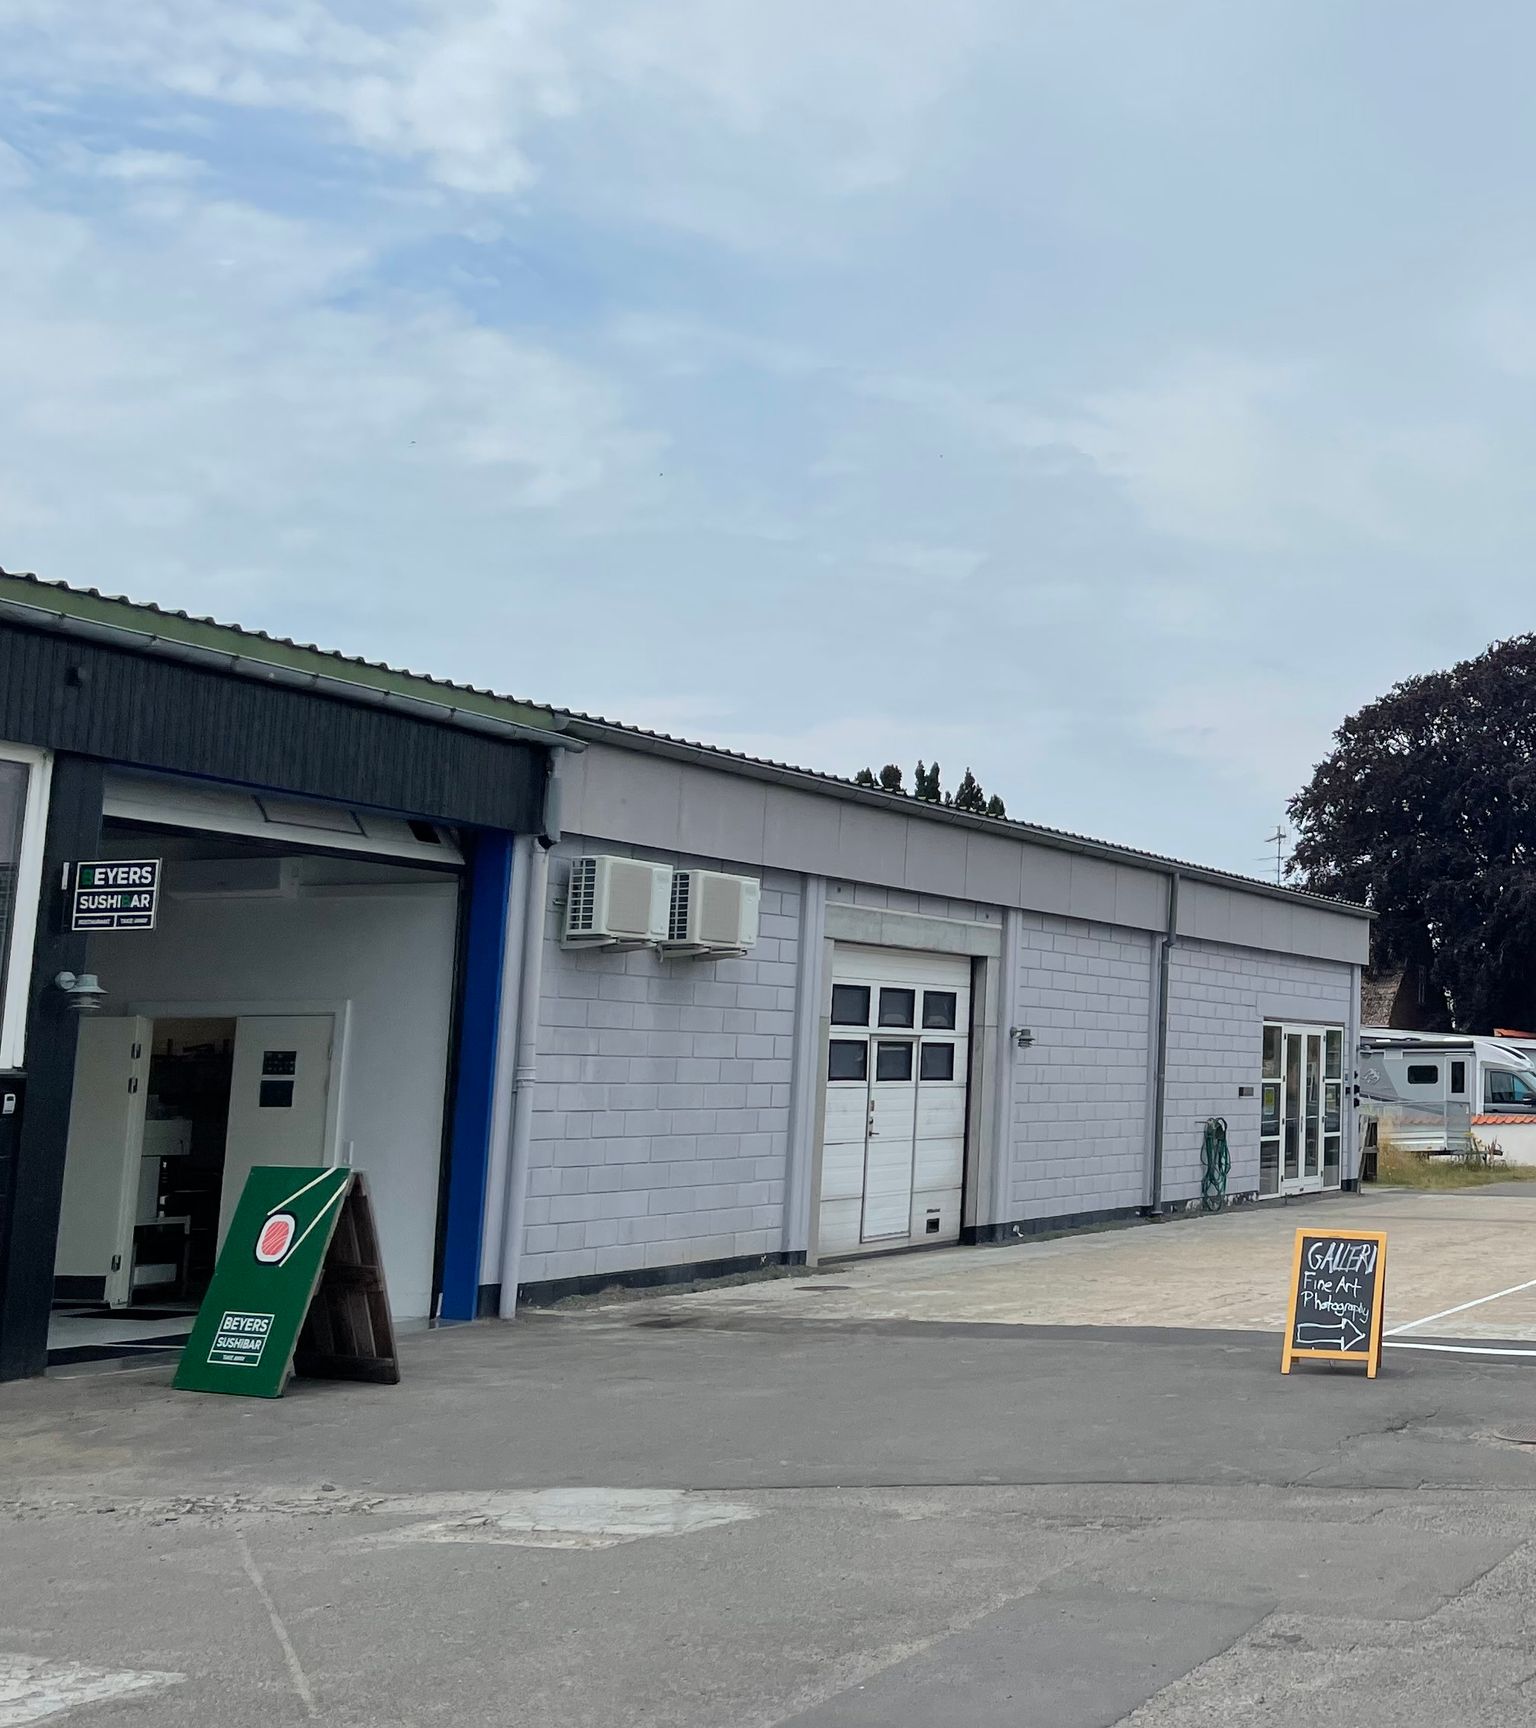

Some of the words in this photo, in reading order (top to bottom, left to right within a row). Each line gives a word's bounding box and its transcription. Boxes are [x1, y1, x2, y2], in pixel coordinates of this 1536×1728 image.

[81, 866, 152, 885] BEYERS
[79, 894, 150, 909] SUSHIBAR
[1308, 1241, 1378, 1275] GALLERI
[1303, 1271, 1333, 1293] Fine
[1335, 1276, 1363, 1298] Art
[1301, 1290, 1370, 1324] Photography
[223, 1316, 269, 1332] BEYERS
[216, 1336, 262, 1350] SUSHIBAR
